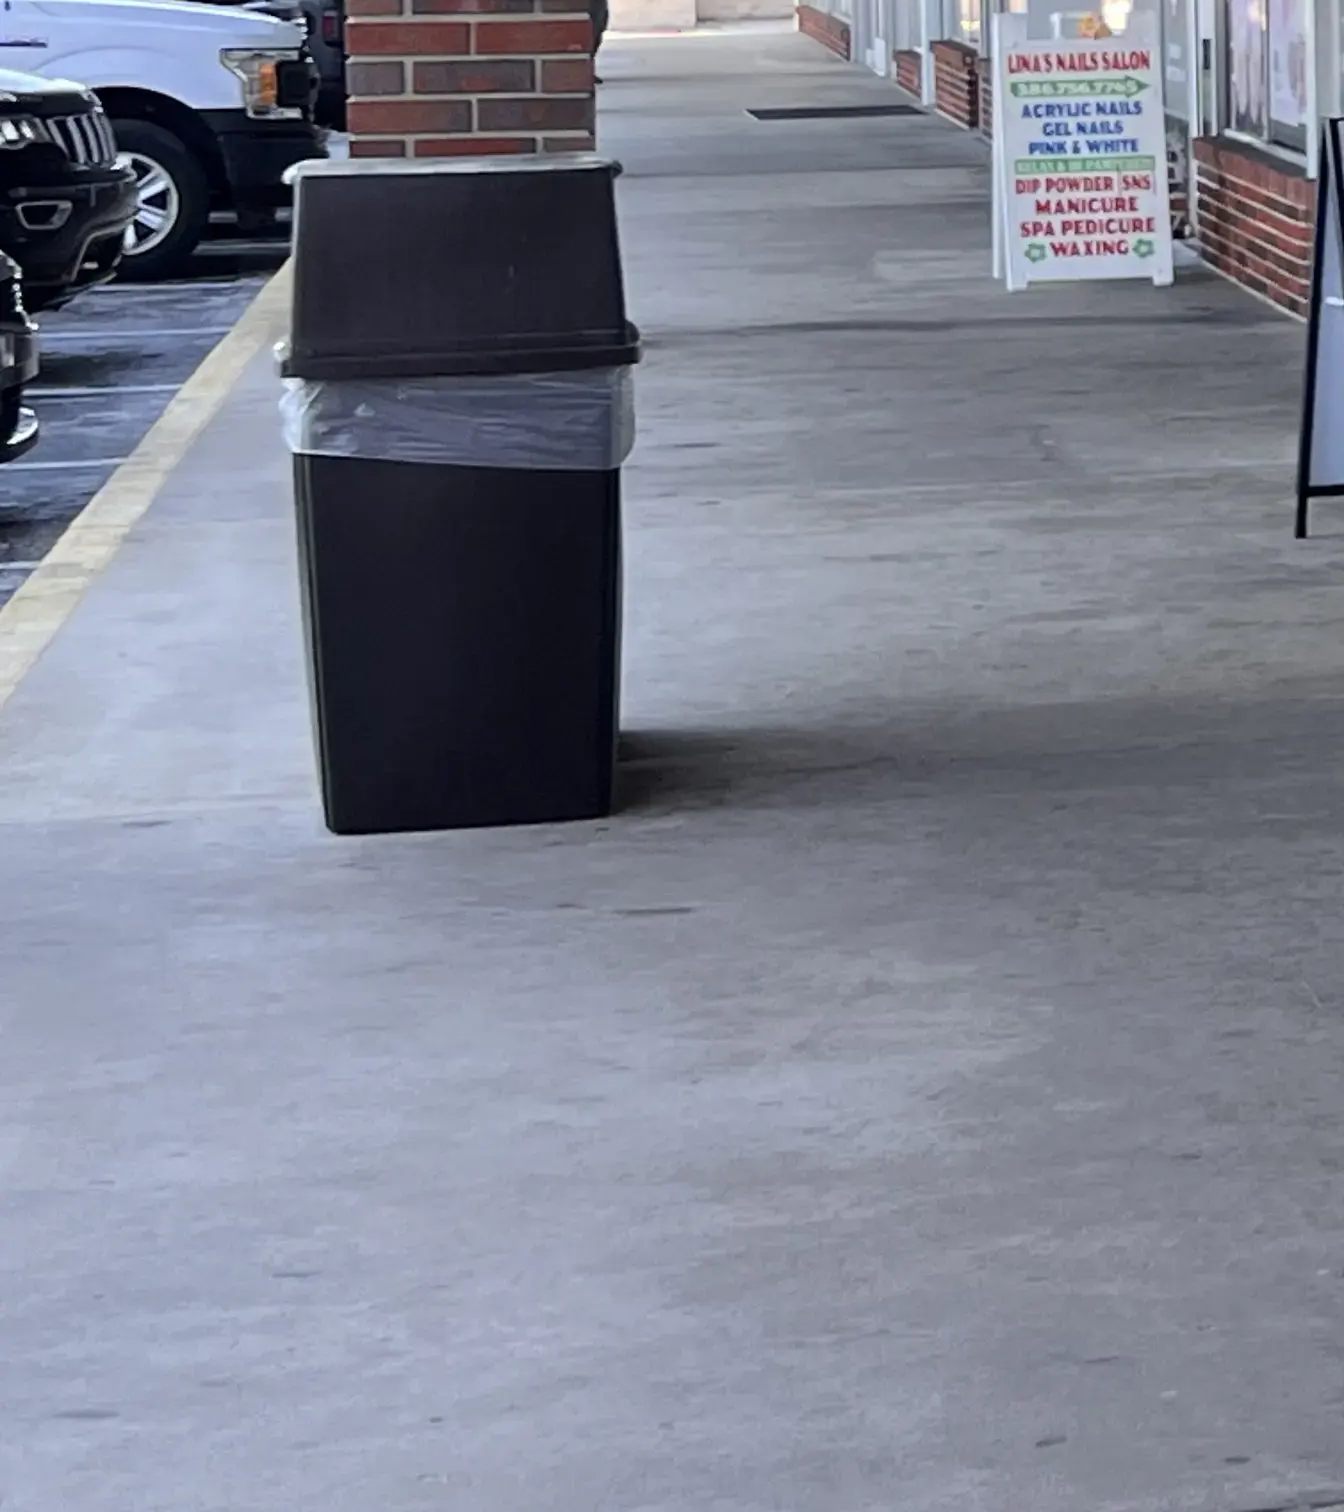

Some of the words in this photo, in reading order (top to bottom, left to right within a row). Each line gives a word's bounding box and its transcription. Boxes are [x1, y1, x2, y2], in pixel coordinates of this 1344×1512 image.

[1007, 52, 1053, 74] LINA'S
[1056, 51, 1098, 72] NAILS
[1102, 50, 1151, 71] SALON
[1021, 101, 1092, 119] ACRYLIC
[1095, 100, 1143, 117] NAILS
[1042, 121, 1073, 138] GEL
[1076, 120, 1124, 136] NAILS
[1027, 140, 1067, 156] PINK
[1072, 140, 1082, 155] &
[1085, 138, 1139, 154] WHITE
[1015, 178, 1042, 195] DIP
[1045, 175, 1114, 194] POWDER
[1121, 174, 1151, 191] SNS
[1034, 196, 1139, 216] MANICURE
[1019, 222, 1055, 238] SPA
[1061, 217, 1156, 237] PEDICURE
[1049, 239, 1130, 257] WAXING
